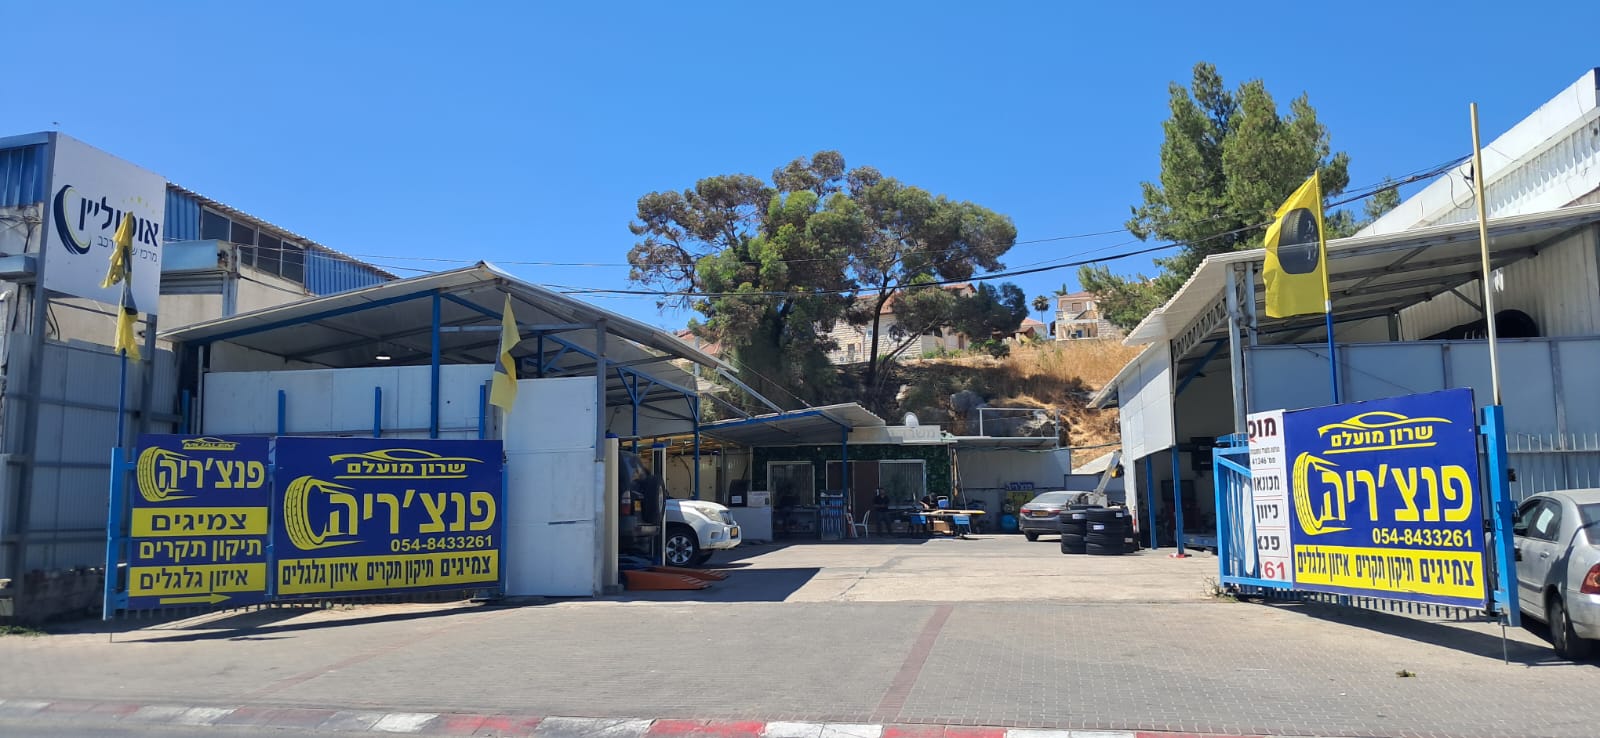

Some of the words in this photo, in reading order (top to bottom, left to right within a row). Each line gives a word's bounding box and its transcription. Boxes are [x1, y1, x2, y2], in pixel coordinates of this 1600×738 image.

[79, 196, 159, 247] אווליין
[140, 248, 158, 263] מרכז
[1330, 429, 1385, 447] מועלם
[1389, 425, 1434, 446] שרון
[158, 457, 265, 489] פנצ'ריה
[346, 460, 414, 474] מועלם
[420, 463, 467, 477] שרון
[1320, 463, 1473, 522] פנצ'ריה
[151, 513, 247, 532] צמיגים
[328, 489, 497, 536] פנצ'ריה
[212, 539, 262, 562] תיקון
[390, 534, 493, 552] 054-8433261
[1372, 528, 1473, 548] 054-8433261
[139, 540, 207, 563] תקרים
[1297, 546, 1327, 575] גלגלים
[140, 566, 204, 590] גלגלים
[282, 559, 326, 585] גלגלים
[329, 563, 359, 589] איזון
[366, 561, 401, 586] תקרים
[405, 559, 434, 585] תיקון
[440, 555, 491, 577] צמיגים
[1260, 561, 1286, 580] 61
[1328, 552, 1350, 582] איזון
[1356, 554, 1385, 587] תקרים
[1387, 556, 1414, 588] תיקון
[1420, 558, 1475, 587] צמיגים
[209, 568, 249, 593] איזון
